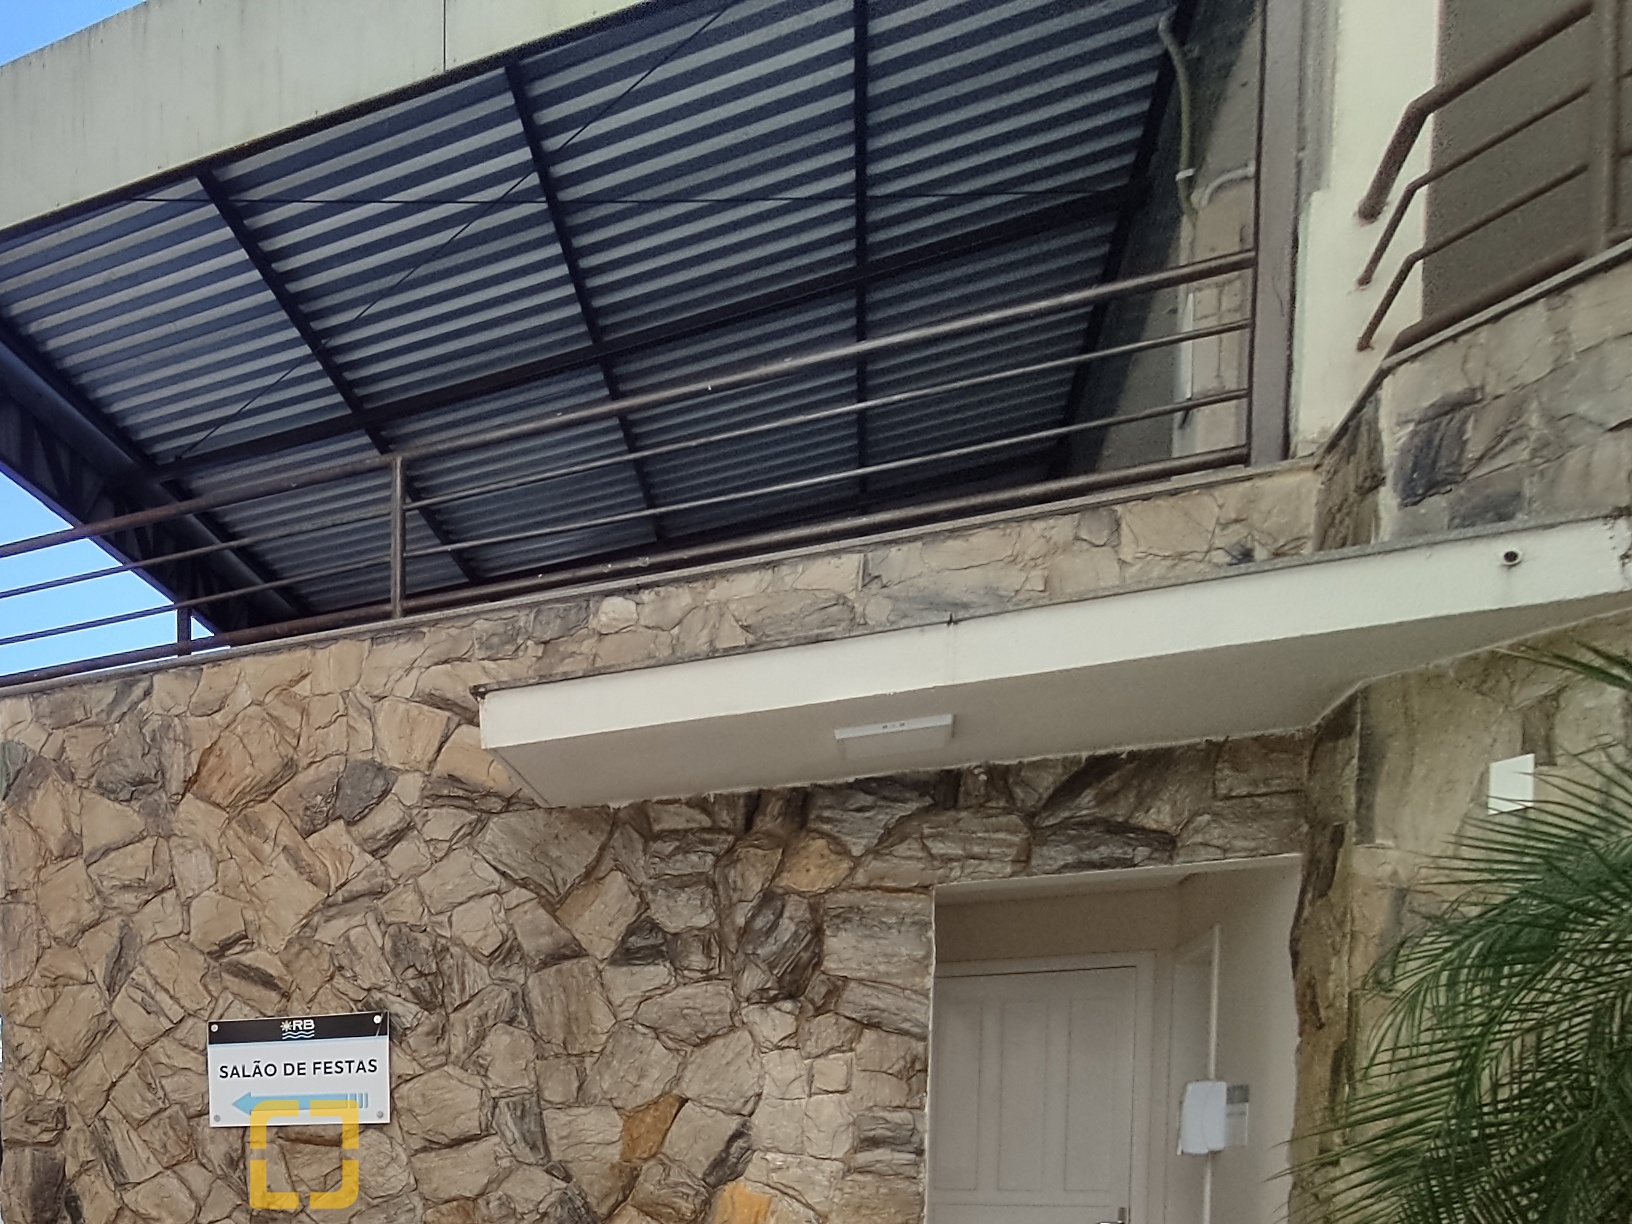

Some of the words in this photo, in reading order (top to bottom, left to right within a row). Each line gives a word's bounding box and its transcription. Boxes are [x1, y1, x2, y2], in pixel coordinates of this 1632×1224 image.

[292, 1019, 315, 1031] RB
[219, 1060, 277, 1079] SALÃO
[283, 1062, 306, 1076] DE
[312, 1059, 378, 1076] FESTAS
